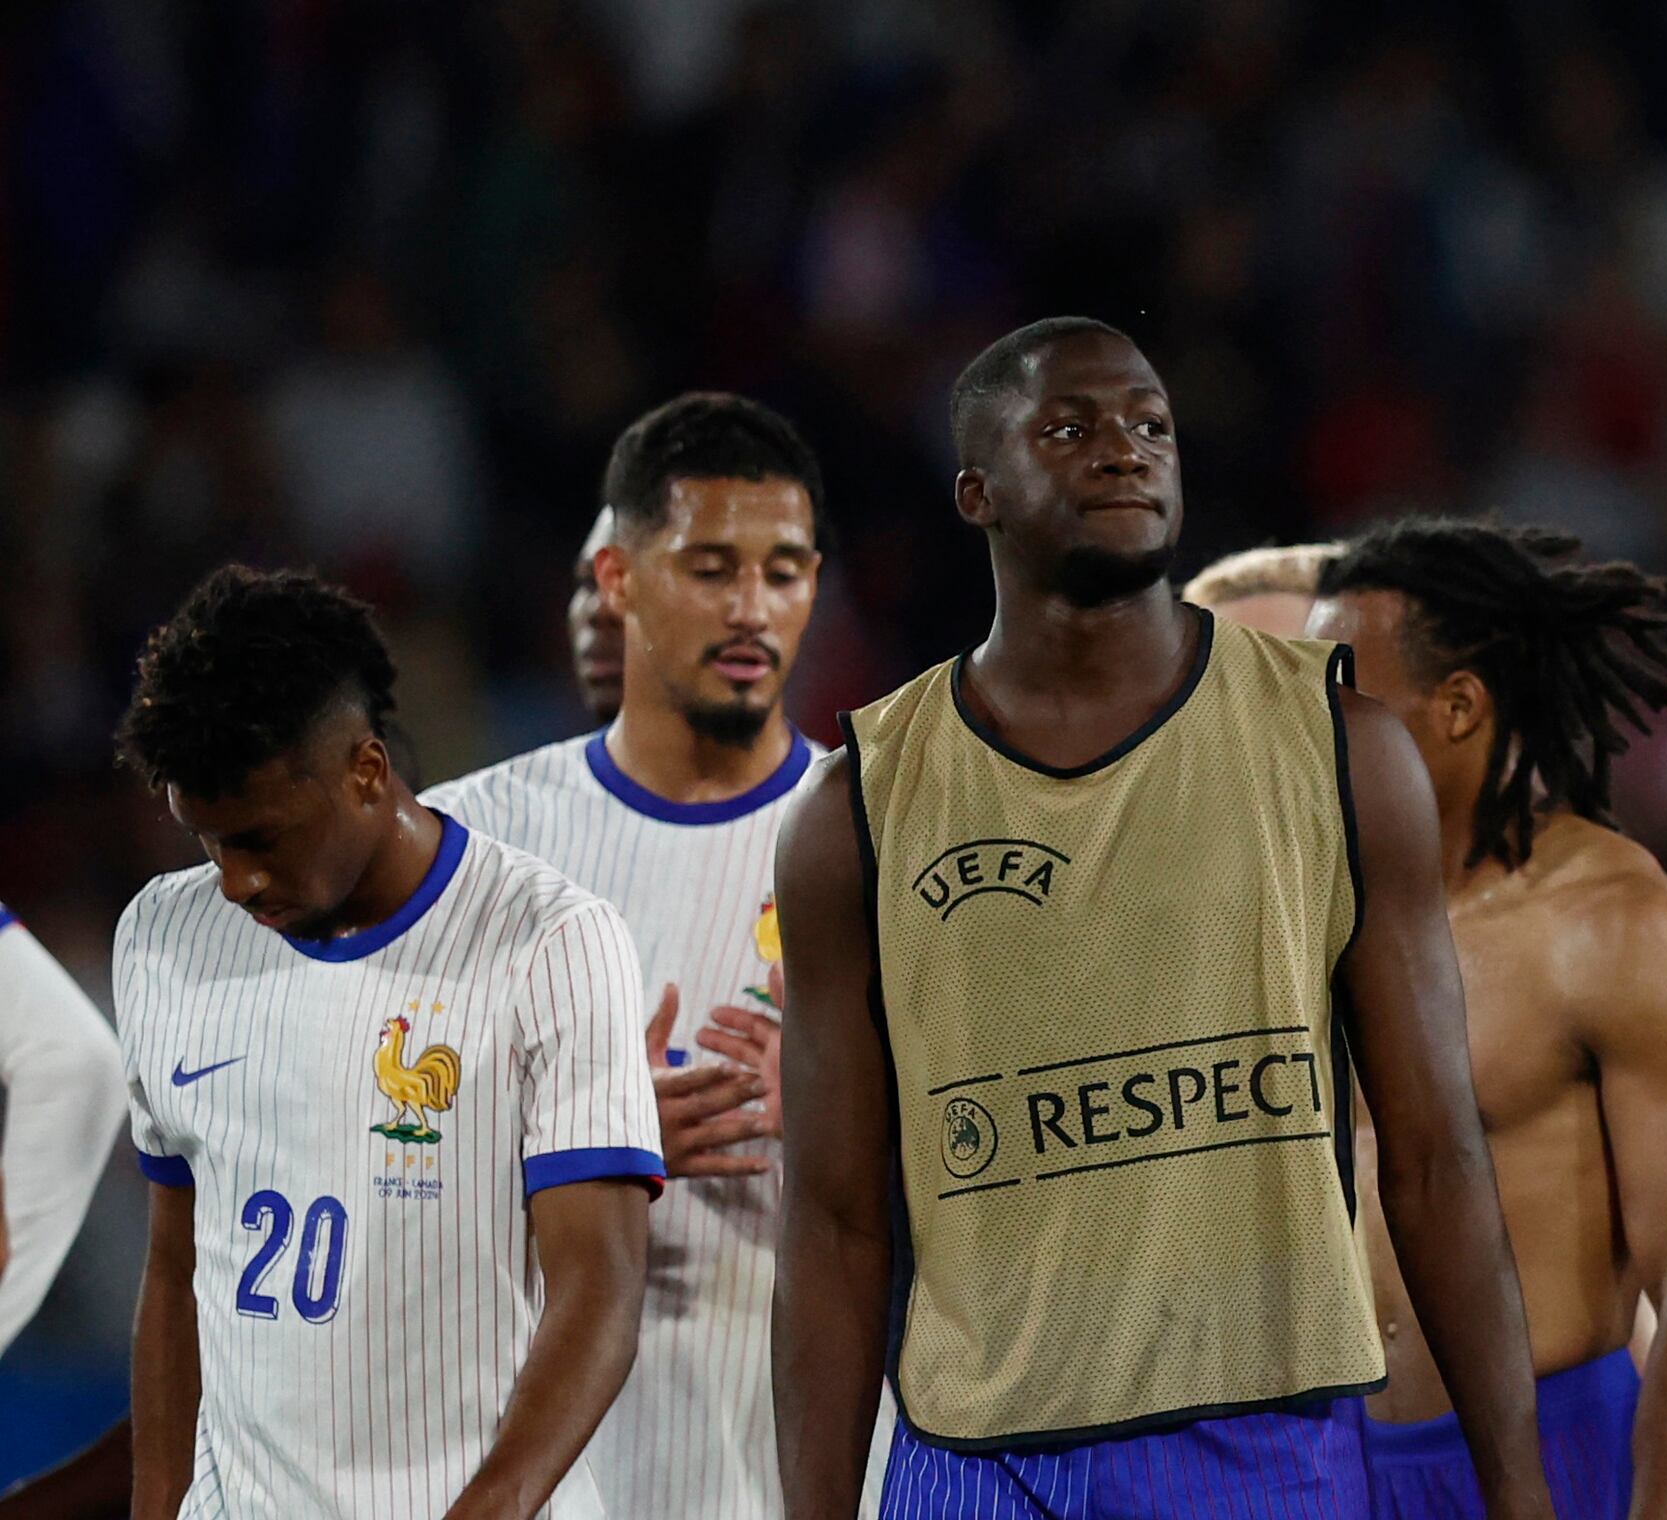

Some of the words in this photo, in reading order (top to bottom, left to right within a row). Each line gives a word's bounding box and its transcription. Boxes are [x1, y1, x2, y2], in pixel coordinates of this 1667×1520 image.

[920, 851, 1054, 909] UEFA
[945, 1103, 976, 1123] UEFA
[1027, 1053, 1322, 1154] RESPECT
[236, 1189, 349, 1325] 20
